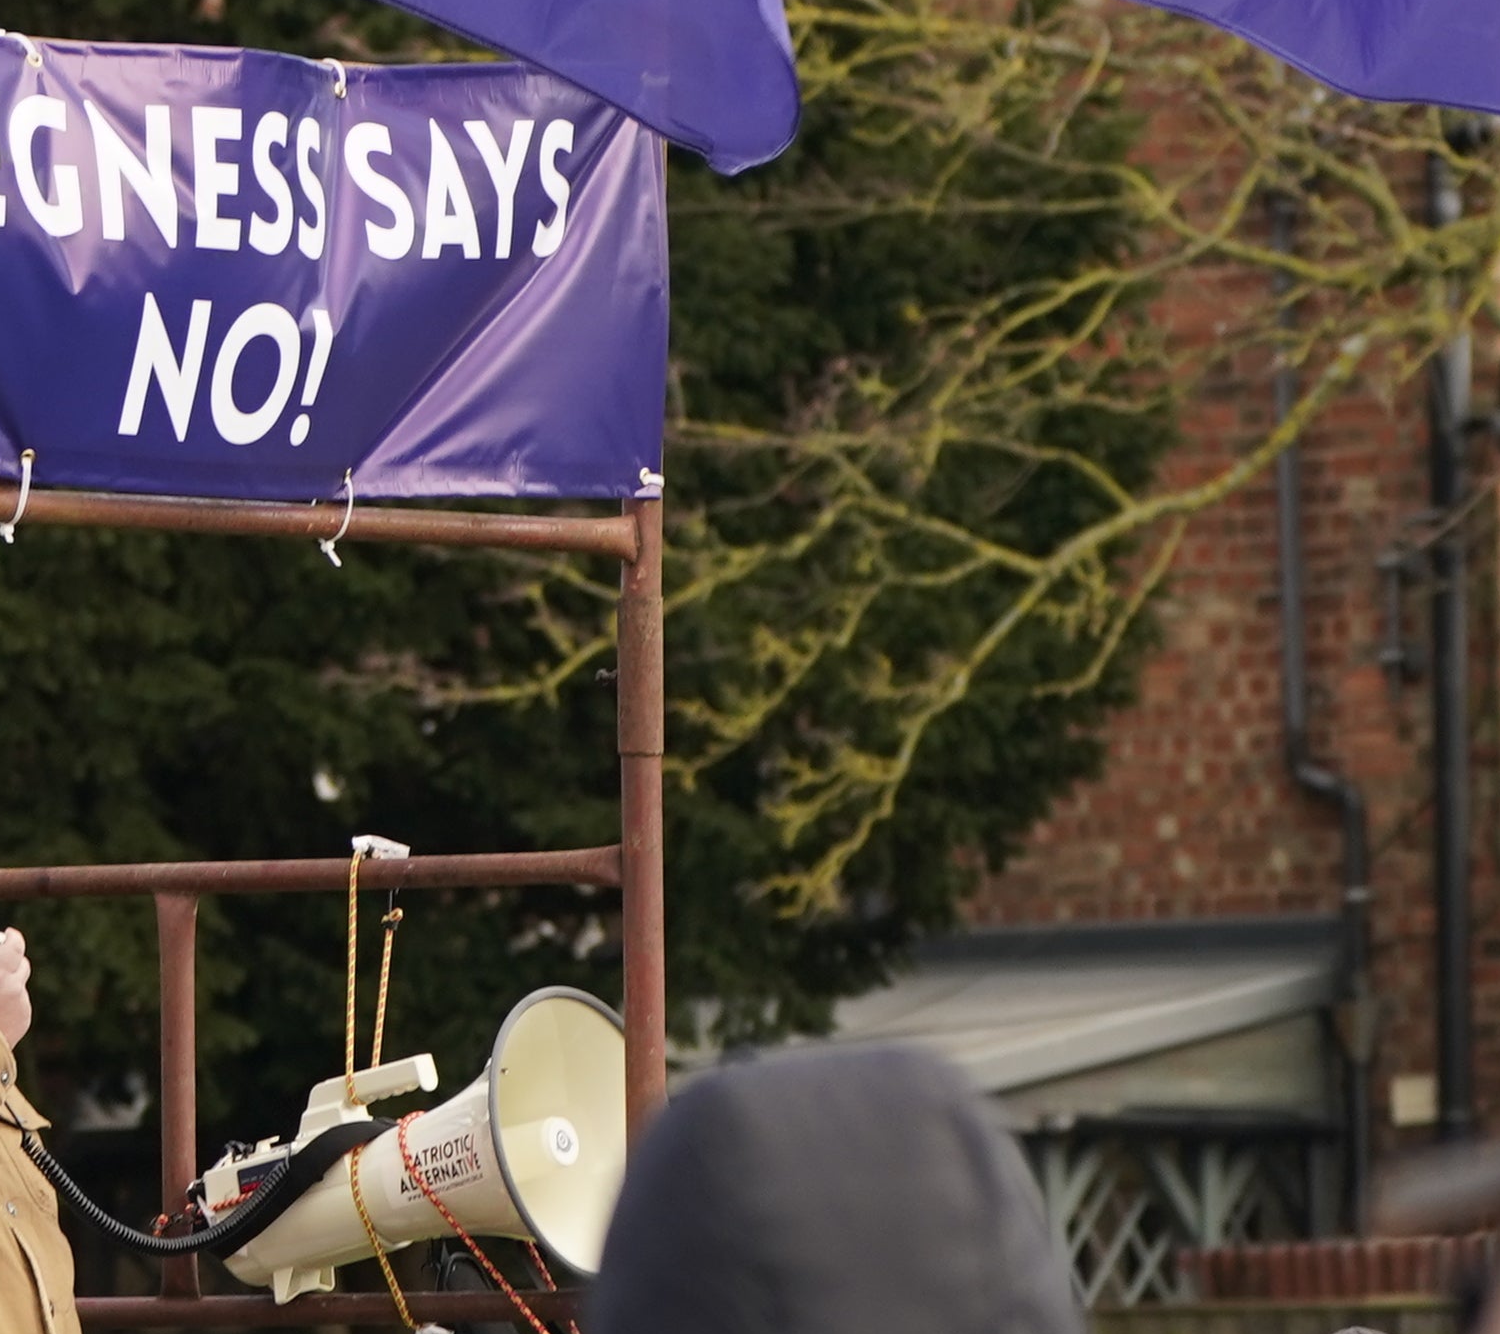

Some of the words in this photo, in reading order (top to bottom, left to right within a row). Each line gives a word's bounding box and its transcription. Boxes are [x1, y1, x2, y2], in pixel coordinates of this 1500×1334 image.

[344, 117, 575, 260] SAYS
[118, 291, 334, 447] NO!
[401, 1135, 481, 1194] ALERNATIVE
